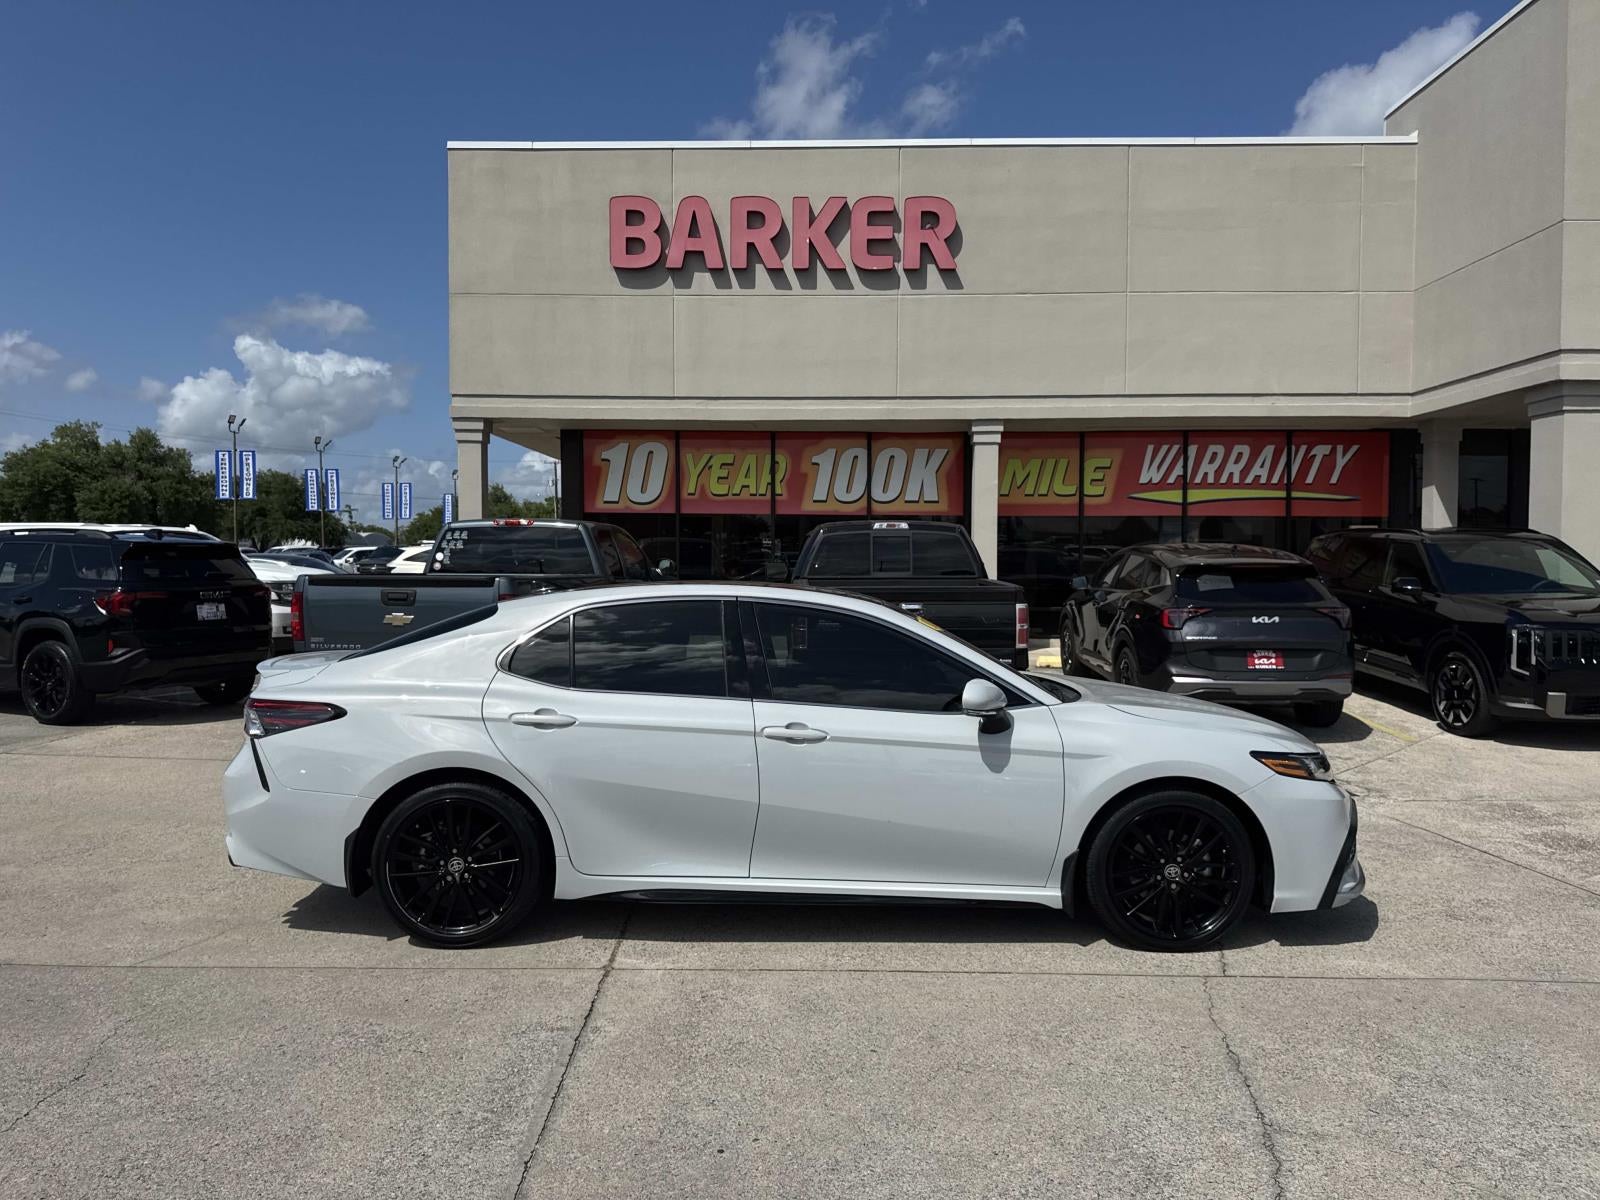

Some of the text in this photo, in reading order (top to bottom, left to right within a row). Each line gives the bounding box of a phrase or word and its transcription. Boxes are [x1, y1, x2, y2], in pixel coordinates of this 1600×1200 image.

[609, 195, 958, 271] BARKER
[601, 441, 1361, 505] 10 YEAR 100K MILE WARRANTY
[1251, 616, 1280, 624] KIA
